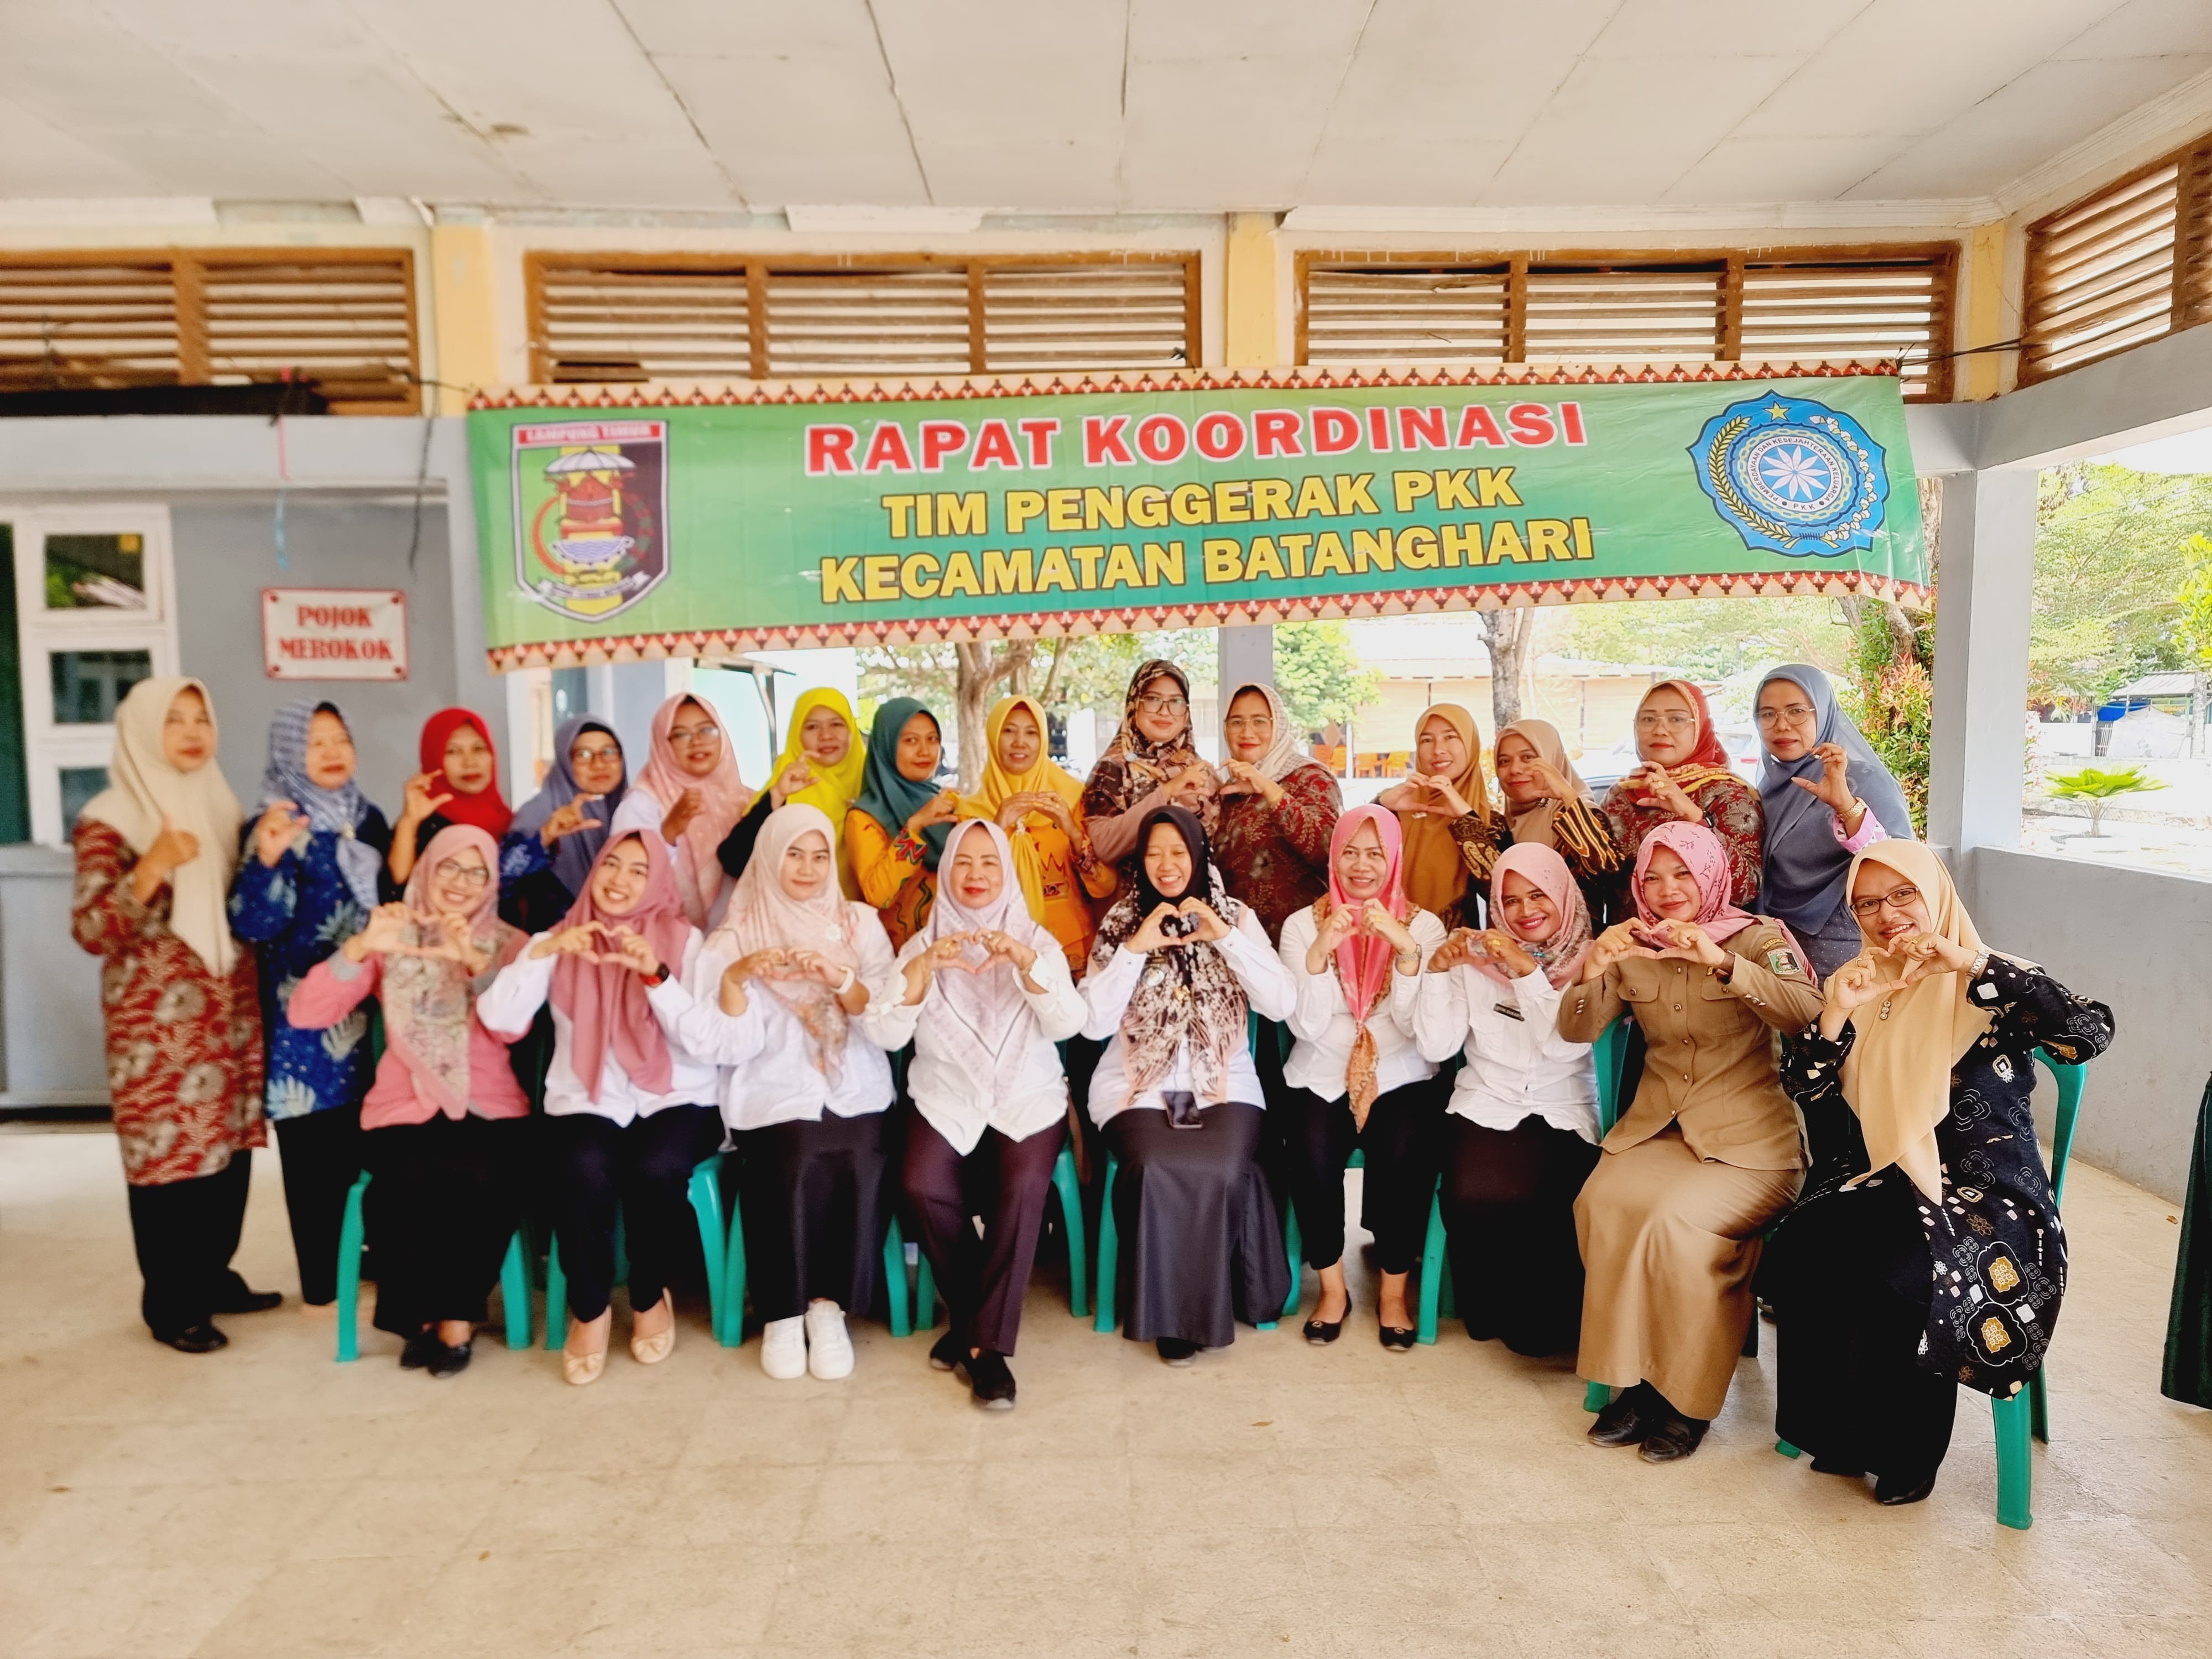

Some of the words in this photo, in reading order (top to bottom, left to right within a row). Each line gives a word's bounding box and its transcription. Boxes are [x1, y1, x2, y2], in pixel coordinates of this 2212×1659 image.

[806, 418, 1060, 476] RAPAT
[1083, 402, 1587, 467] KOORDINASI
[1758, 442, 1772, 452] DAN
[1771, 437, 1835, 466] KESEJAHTERAAN
[1751, 452, 1778, 501] PEMBERDAYAAN
[1824, 467, 1840, 502] KELUARGA
[882, 491, 986, 538] TIM
[1006, 473, 1380, 534] PENGGERAK
[1393, 466, 1524, 513] PKK
[821, 541, 1185, 603] KECAMATAN
[1203, 518, 1594, 585] BATANGHARI
[297, 606, 372, 628] POJOK
[280, 639, 394, 659] MEROKOK
